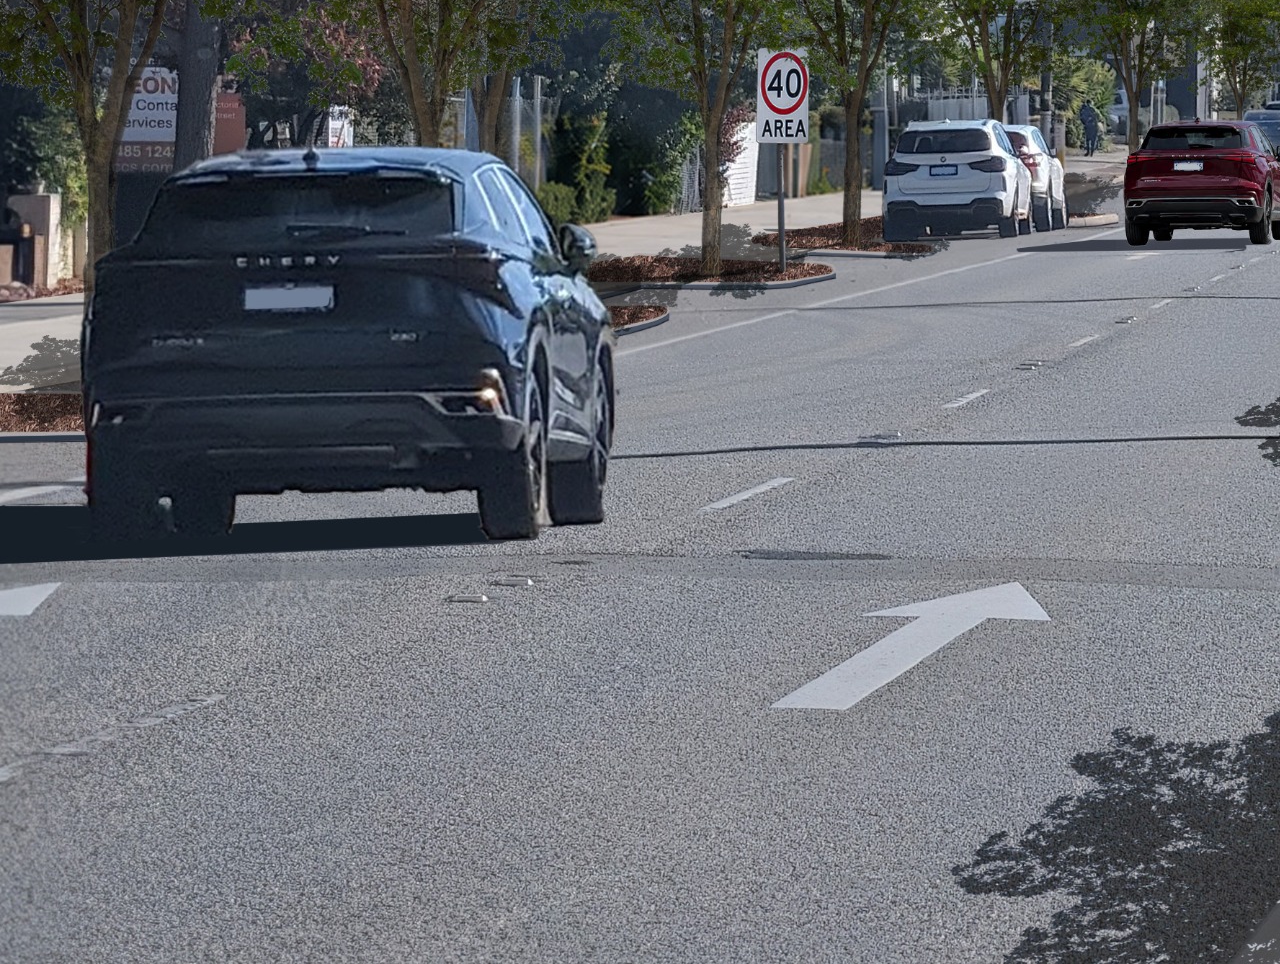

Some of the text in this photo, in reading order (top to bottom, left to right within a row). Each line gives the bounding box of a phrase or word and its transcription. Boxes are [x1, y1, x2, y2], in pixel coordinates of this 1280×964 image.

[133, 76, 179, 94] EON
[767, 68, 801, 98] 40
[762, 119, 806, 137] AREA
[146, 145, 175, 157] 124
[236, 255, 340, 267] CHERY
